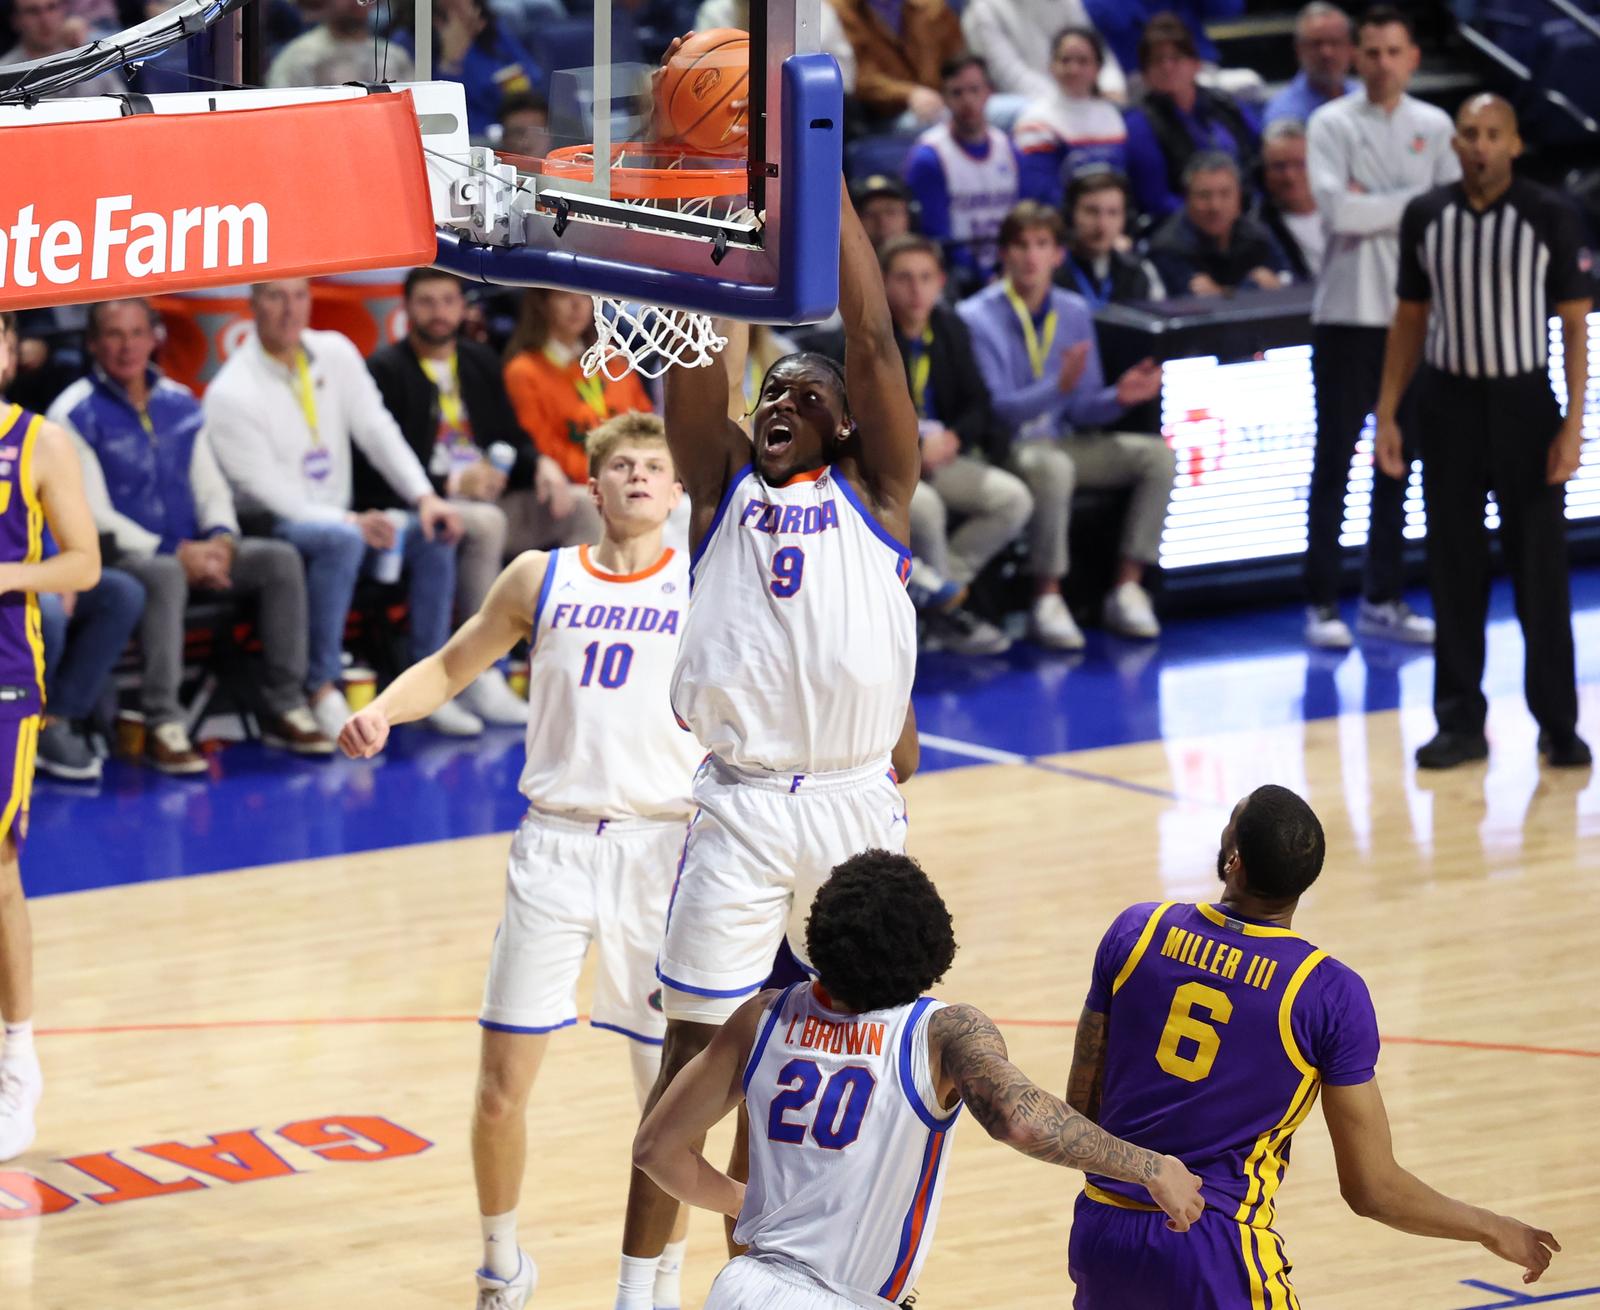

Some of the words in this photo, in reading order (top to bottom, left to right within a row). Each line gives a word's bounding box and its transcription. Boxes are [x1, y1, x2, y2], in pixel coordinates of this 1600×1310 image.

[769, 546, 805, 598] 9
[551, 603, 680, 635] FLORIDA
[579, 641, 634, 690] 10
[1160, 926, 1243, 980] MILLER
[1243, 955, 1278, 991] III
[800, 1015, 886, 1056] BROWN
[1155, 981, 1234, 1083] 6
[767, 1058, 878, 1151] 20
